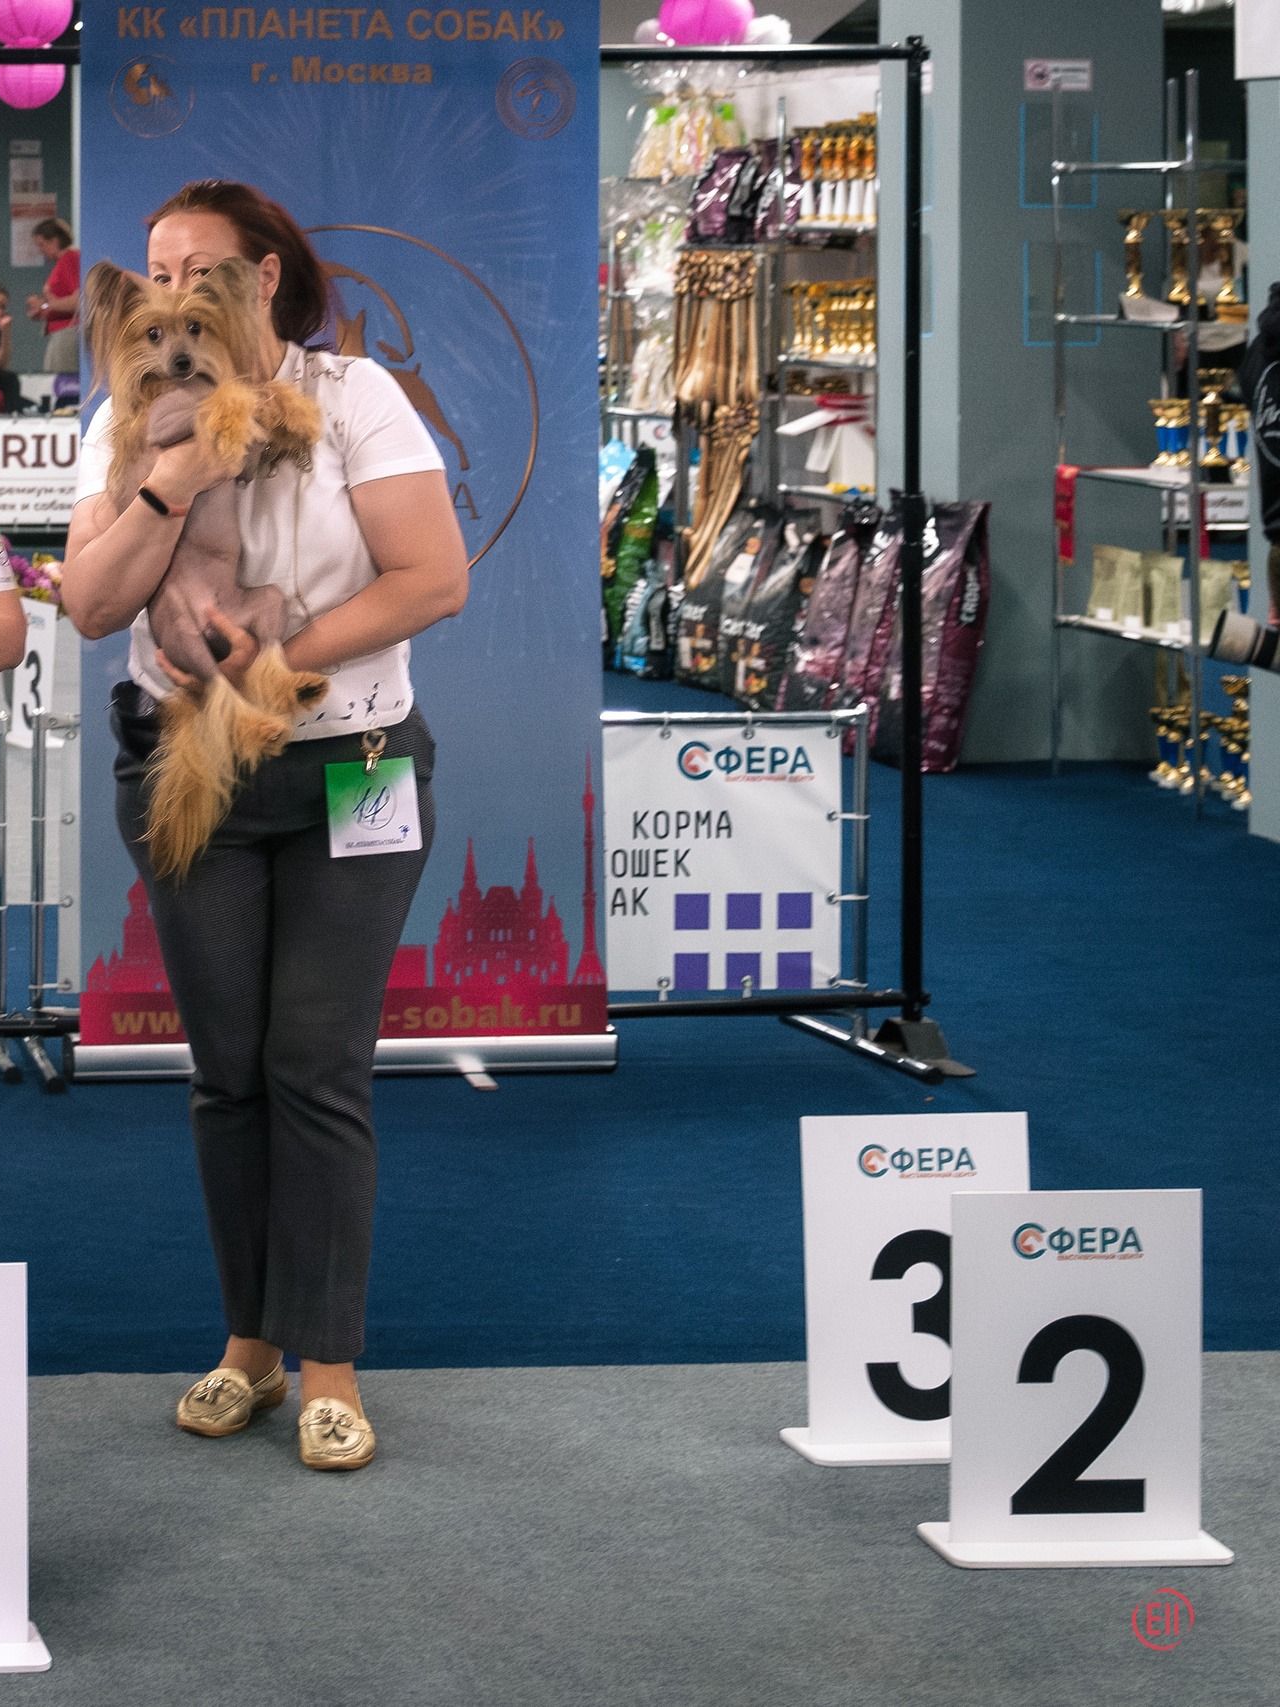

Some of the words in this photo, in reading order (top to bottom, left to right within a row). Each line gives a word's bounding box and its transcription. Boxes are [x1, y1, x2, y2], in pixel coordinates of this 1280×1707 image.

[117, 7, 167, 38] КК
[179, 7, 394, 40] «ПЛАНЕТА
[406, 8, 565, 41] СОБАК»
[250, 62, 278, 83] г.
[291, 56, 433, 83] Москва
[22, 650, 42, 730] 3
[677, 741, 814, 780] СФЕРА
[632, 810, 733, 839] КОРМА
[605, 849, 692, 878] ОШЕК
[381, 995, 582, 1030] -sobak.ru
[858, 1144, 976, 1178] СФЕРА
[1012, 1222, 1143, 1260] СФЕРА
[865, 1229, 951, 1422] 3
[1010, 1314, 1146, 1515] 2
